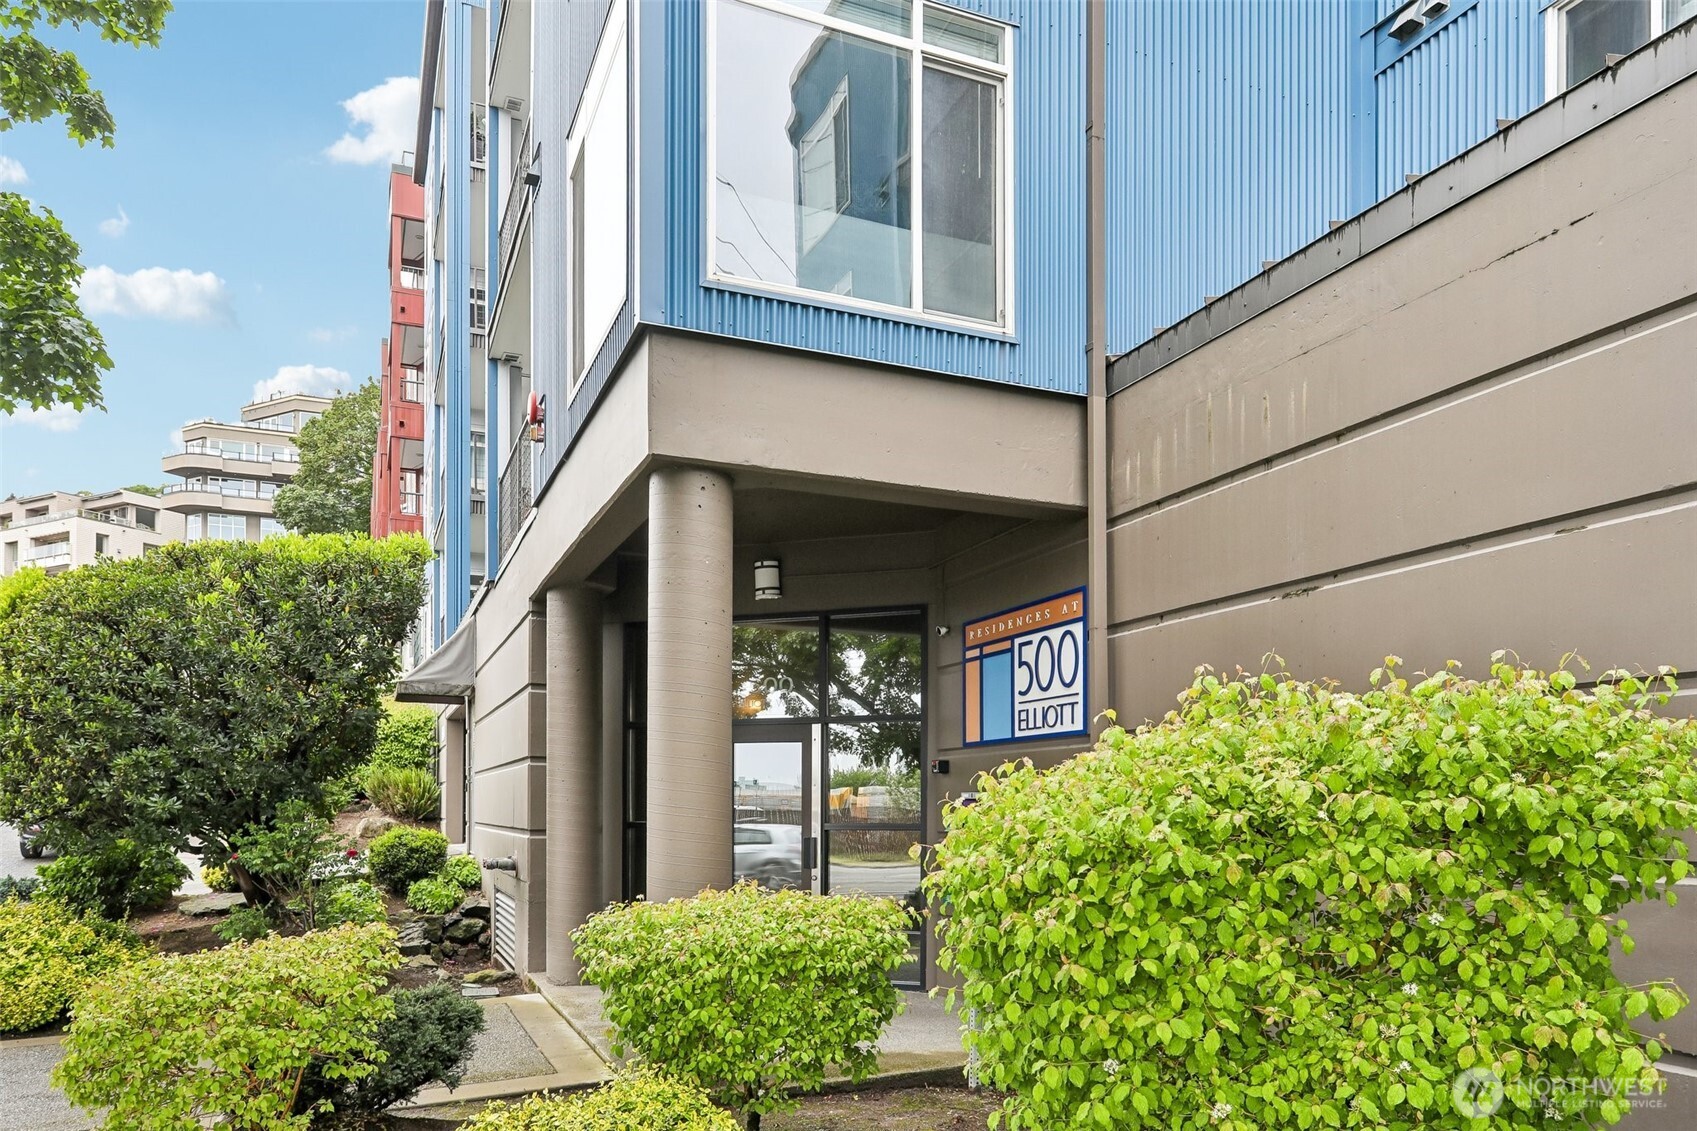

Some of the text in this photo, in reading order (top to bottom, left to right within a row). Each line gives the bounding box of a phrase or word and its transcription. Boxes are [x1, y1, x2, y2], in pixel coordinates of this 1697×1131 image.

[969, 600, 1079, 640] RESIDENCES AT
[1018, 629, 1079, 696] 500
[1018, 702, 1079, 731] ELLIOTT
